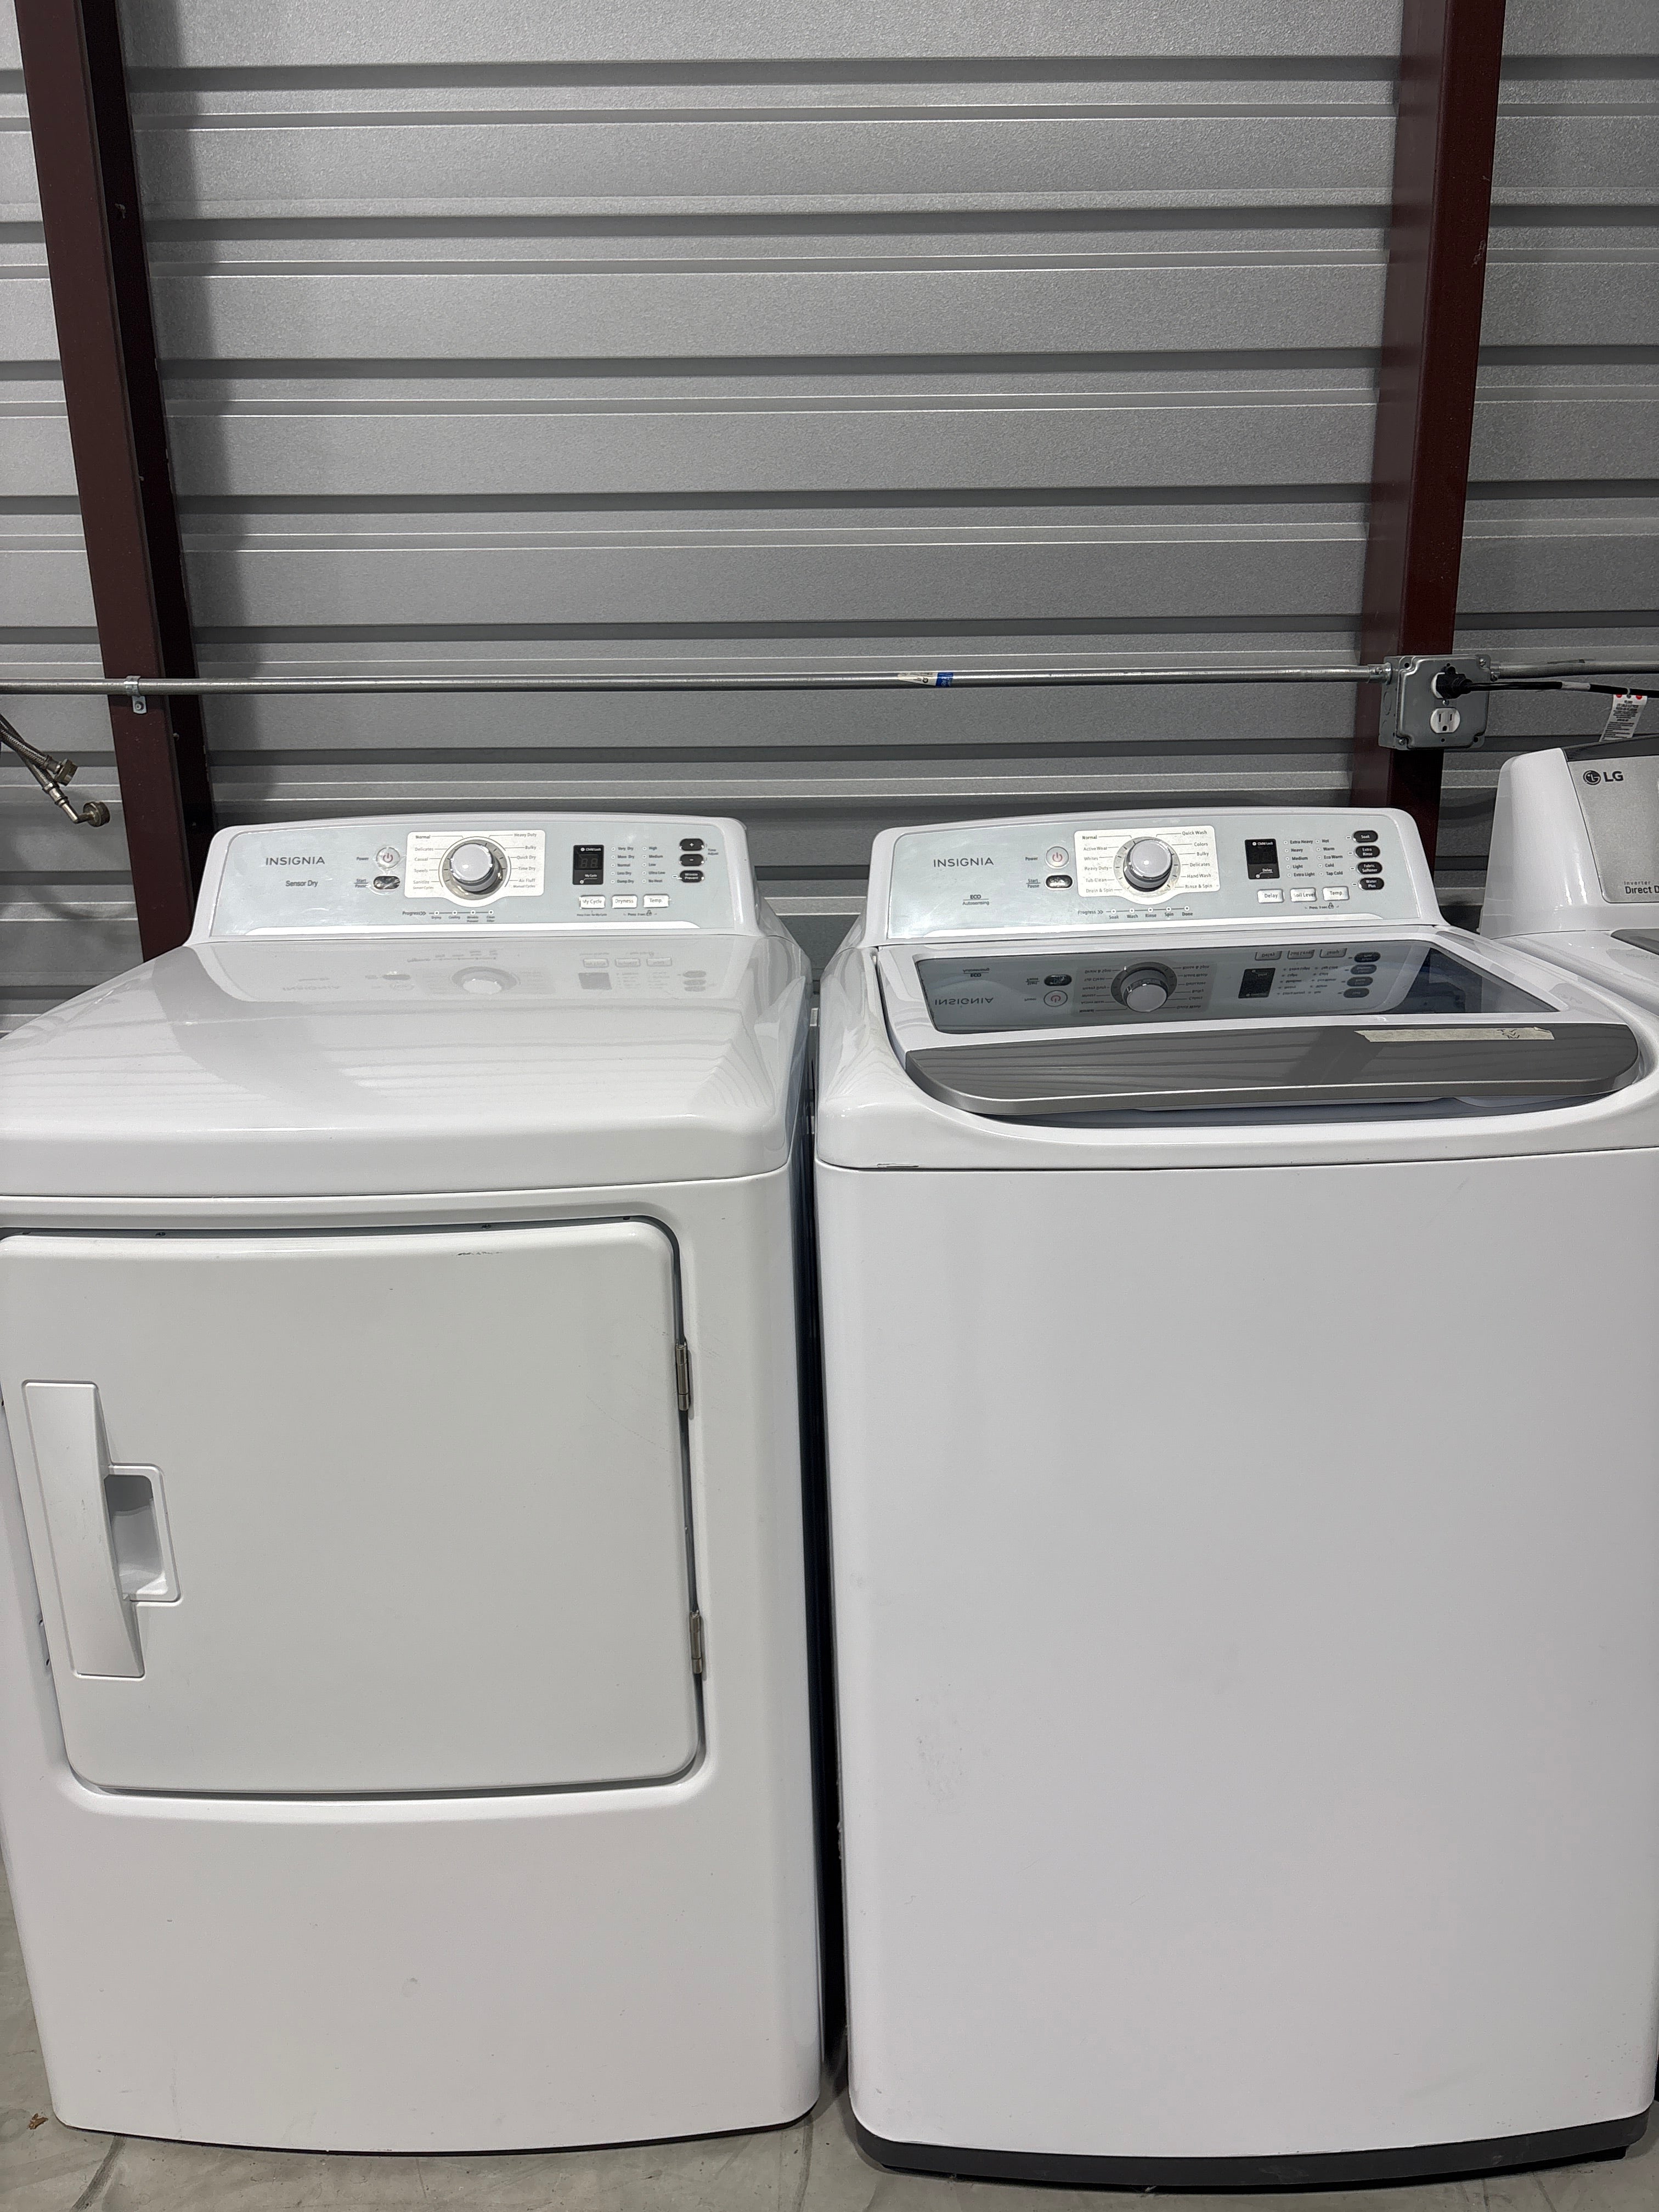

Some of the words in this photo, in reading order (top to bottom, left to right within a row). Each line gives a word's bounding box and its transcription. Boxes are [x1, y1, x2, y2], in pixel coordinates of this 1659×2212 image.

[1603, 771, 1624, 782] LG
[266, 856, 325, 865] INSIGNIA
[933, 857, 994, 867] INSIGNIA
